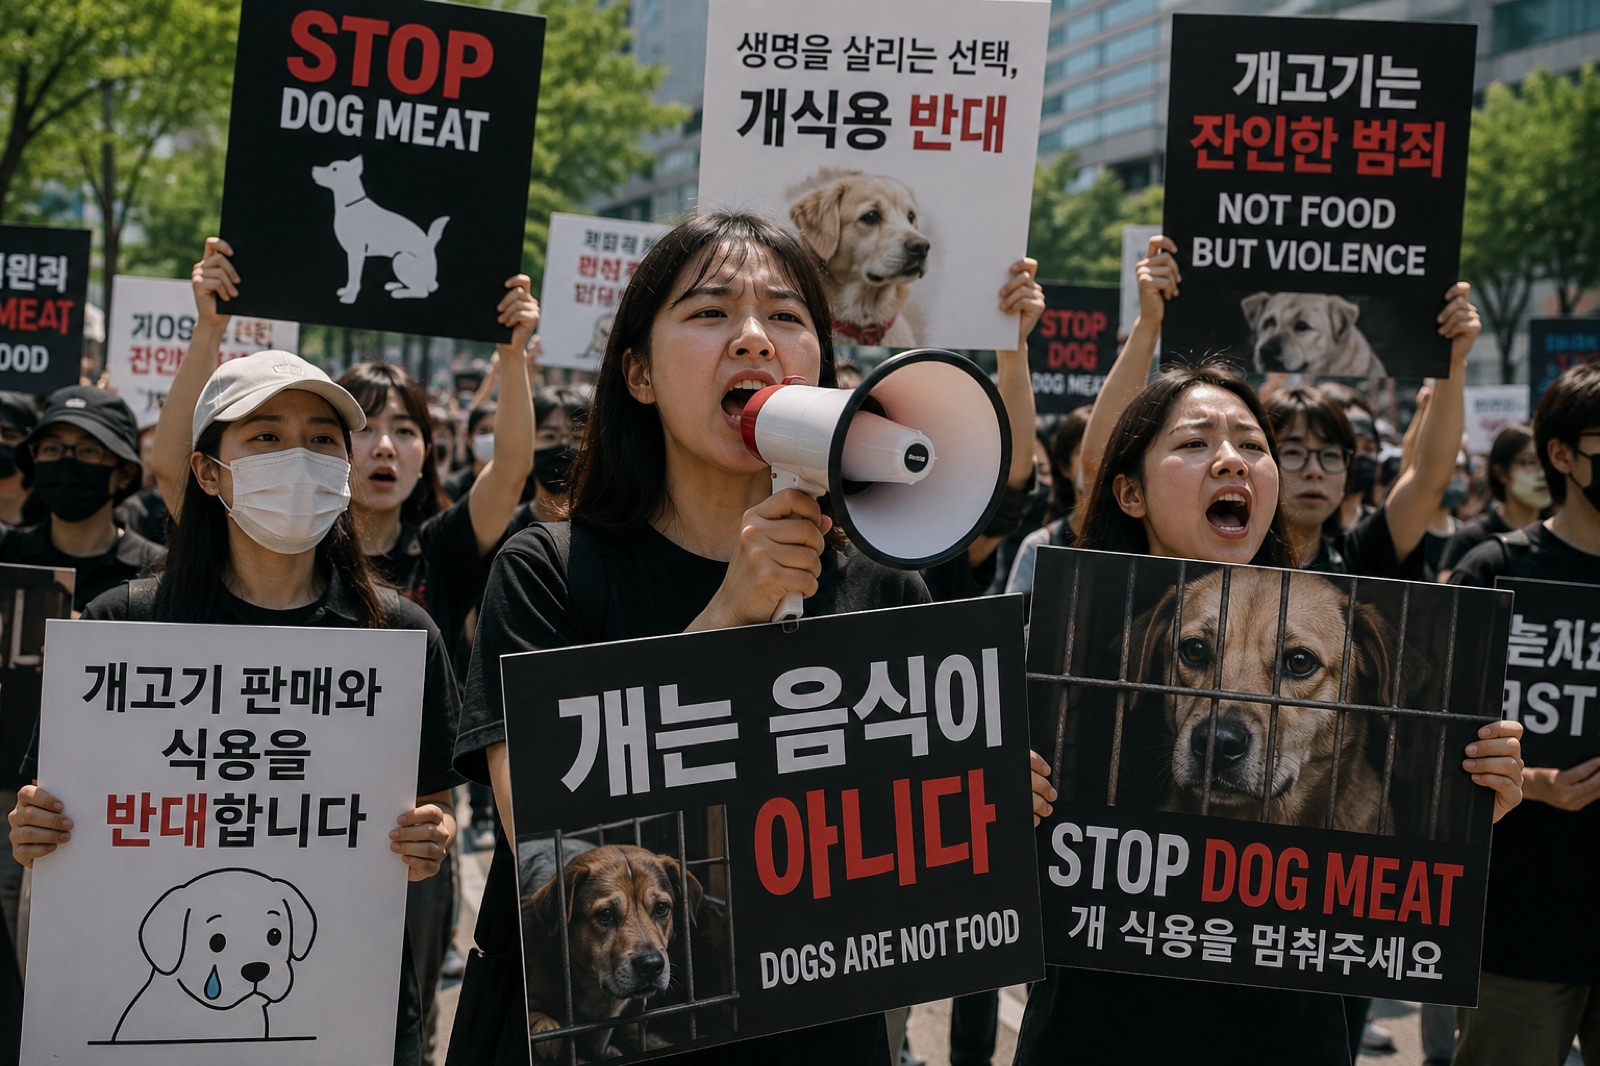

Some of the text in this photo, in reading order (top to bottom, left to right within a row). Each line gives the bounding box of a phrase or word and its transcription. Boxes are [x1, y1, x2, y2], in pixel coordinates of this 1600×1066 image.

[287, 10, 493, 98] STOP
[737, 33, 1017, 79] 생명을 살리는 선택,
[1233, 51, 1421, 109] 개고기는
[281, 87, 489, 152] DOG MEAT
[737, 89, 1006, 153] 개식용 반대
[1191, 114, 1444, 177] 잔인한 범죄
[1219, 193, 1395, 229] NOT FOOD
[1193, 237, 1426, 275] BUT VIOLENCE
[1041, 309, 1107, 339] STOP
[1048, 342, 1097, 370] DOG
[83, 662, 382, 716] 개고기 판매와
[559, 648, 1002, 796] 개는 음식이
[162, 729, 311, 781] 식용을
[107, 793, 366, 848] 반대합니다
[755, 769, 996, 899] 아니다
[1049, 823, 1463, 926] STOP DOG MEAT
[760, 909, 1019, 989] DOGS ARE NOT FOOD
[1068, 906, 1442, 980] 개 식용을 멈춰주세요
